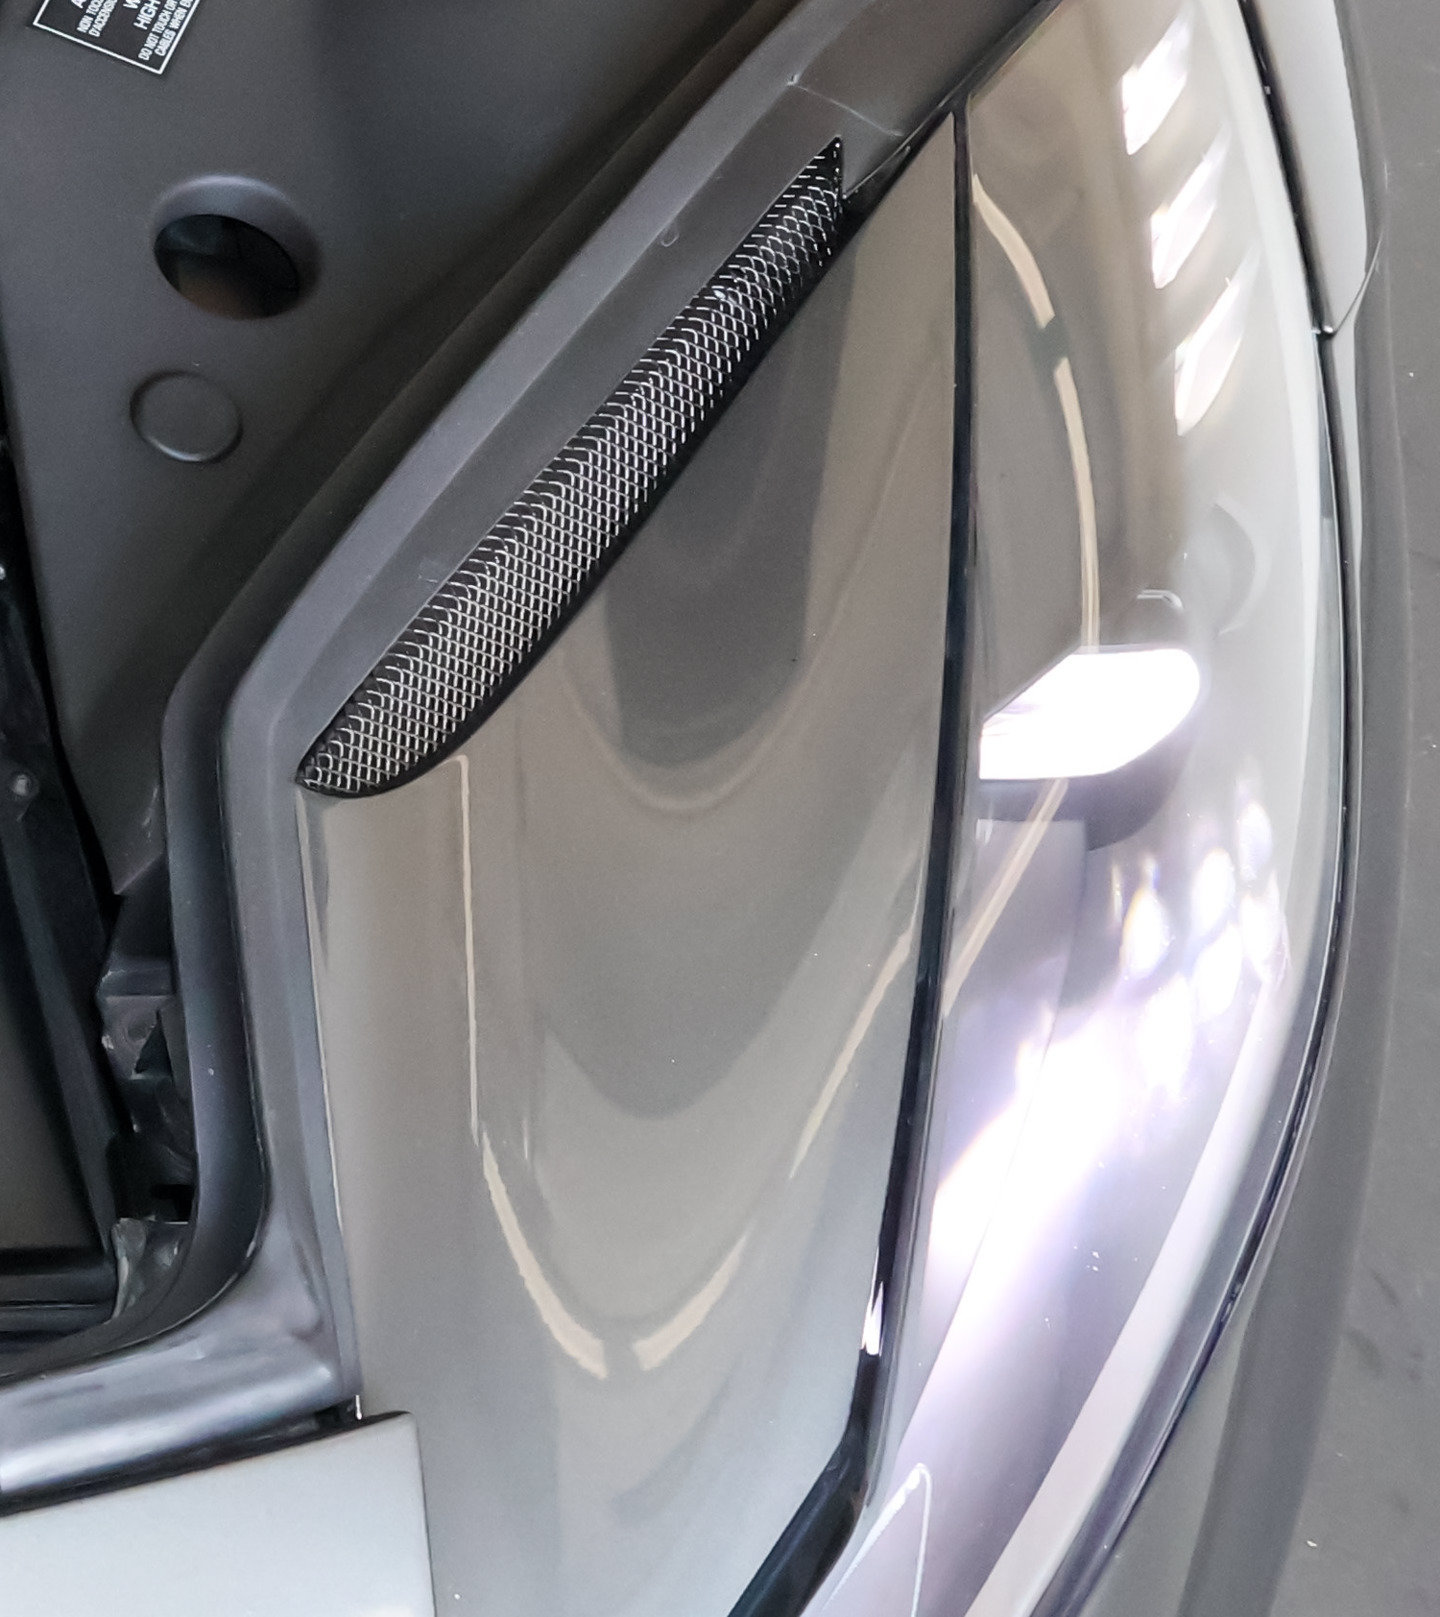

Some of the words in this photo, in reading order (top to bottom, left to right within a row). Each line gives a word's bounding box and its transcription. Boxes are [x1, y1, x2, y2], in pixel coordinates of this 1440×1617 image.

[164, 0, 177, 11] OR
[77, 16, 93, 33] NON
[152, 10, 172, 33] TOUCH
[155, 29, 176, 56] CABLES
[169, 7, 187, 29] WHEN
[144, 33, 159, 49] NOT
[138, 48, 152, 60] DO
